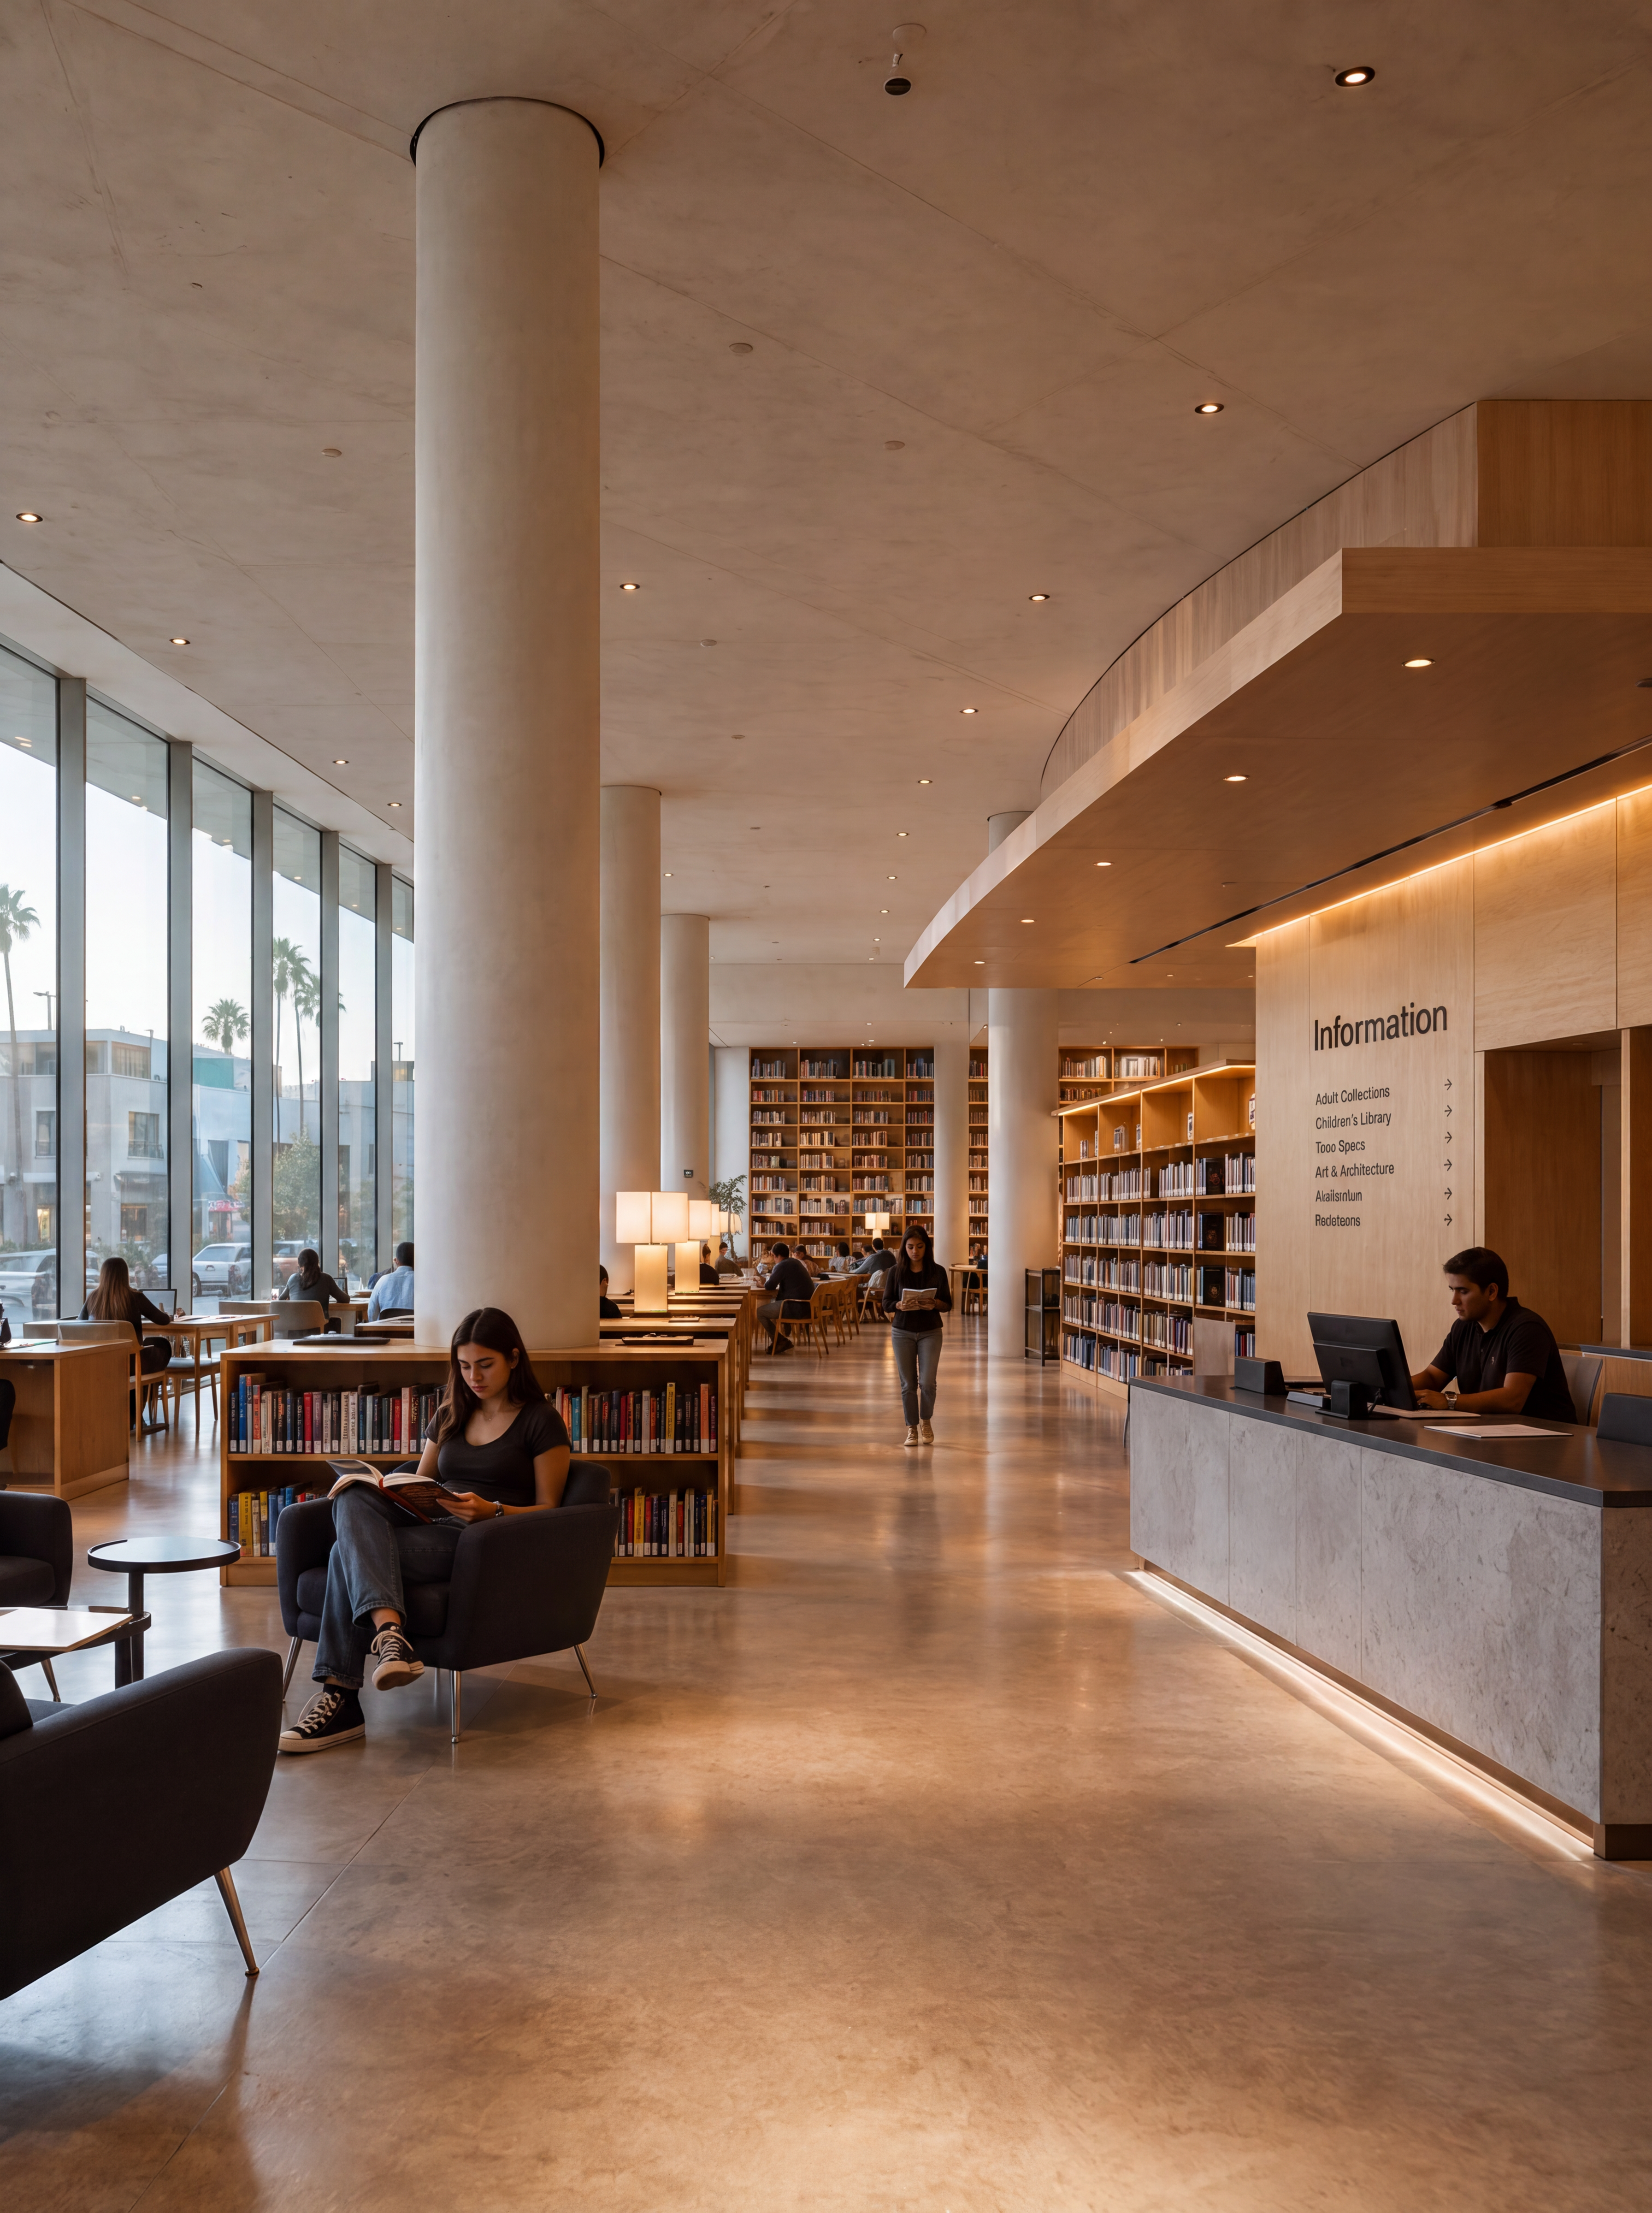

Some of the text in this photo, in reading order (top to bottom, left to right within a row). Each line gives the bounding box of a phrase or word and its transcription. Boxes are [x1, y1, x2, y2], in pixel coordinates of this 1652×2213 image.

[1314, 1001, 1448, 1051] Information
[1315, 1086, 1390, 1106] Adult Collections
[1316, 1112, 1392, 1130] Children's Library
[1316, 1139, 1366, 1155] Tooo Specs
[1315, 1162, 1394, 1178] Art & Architecture
